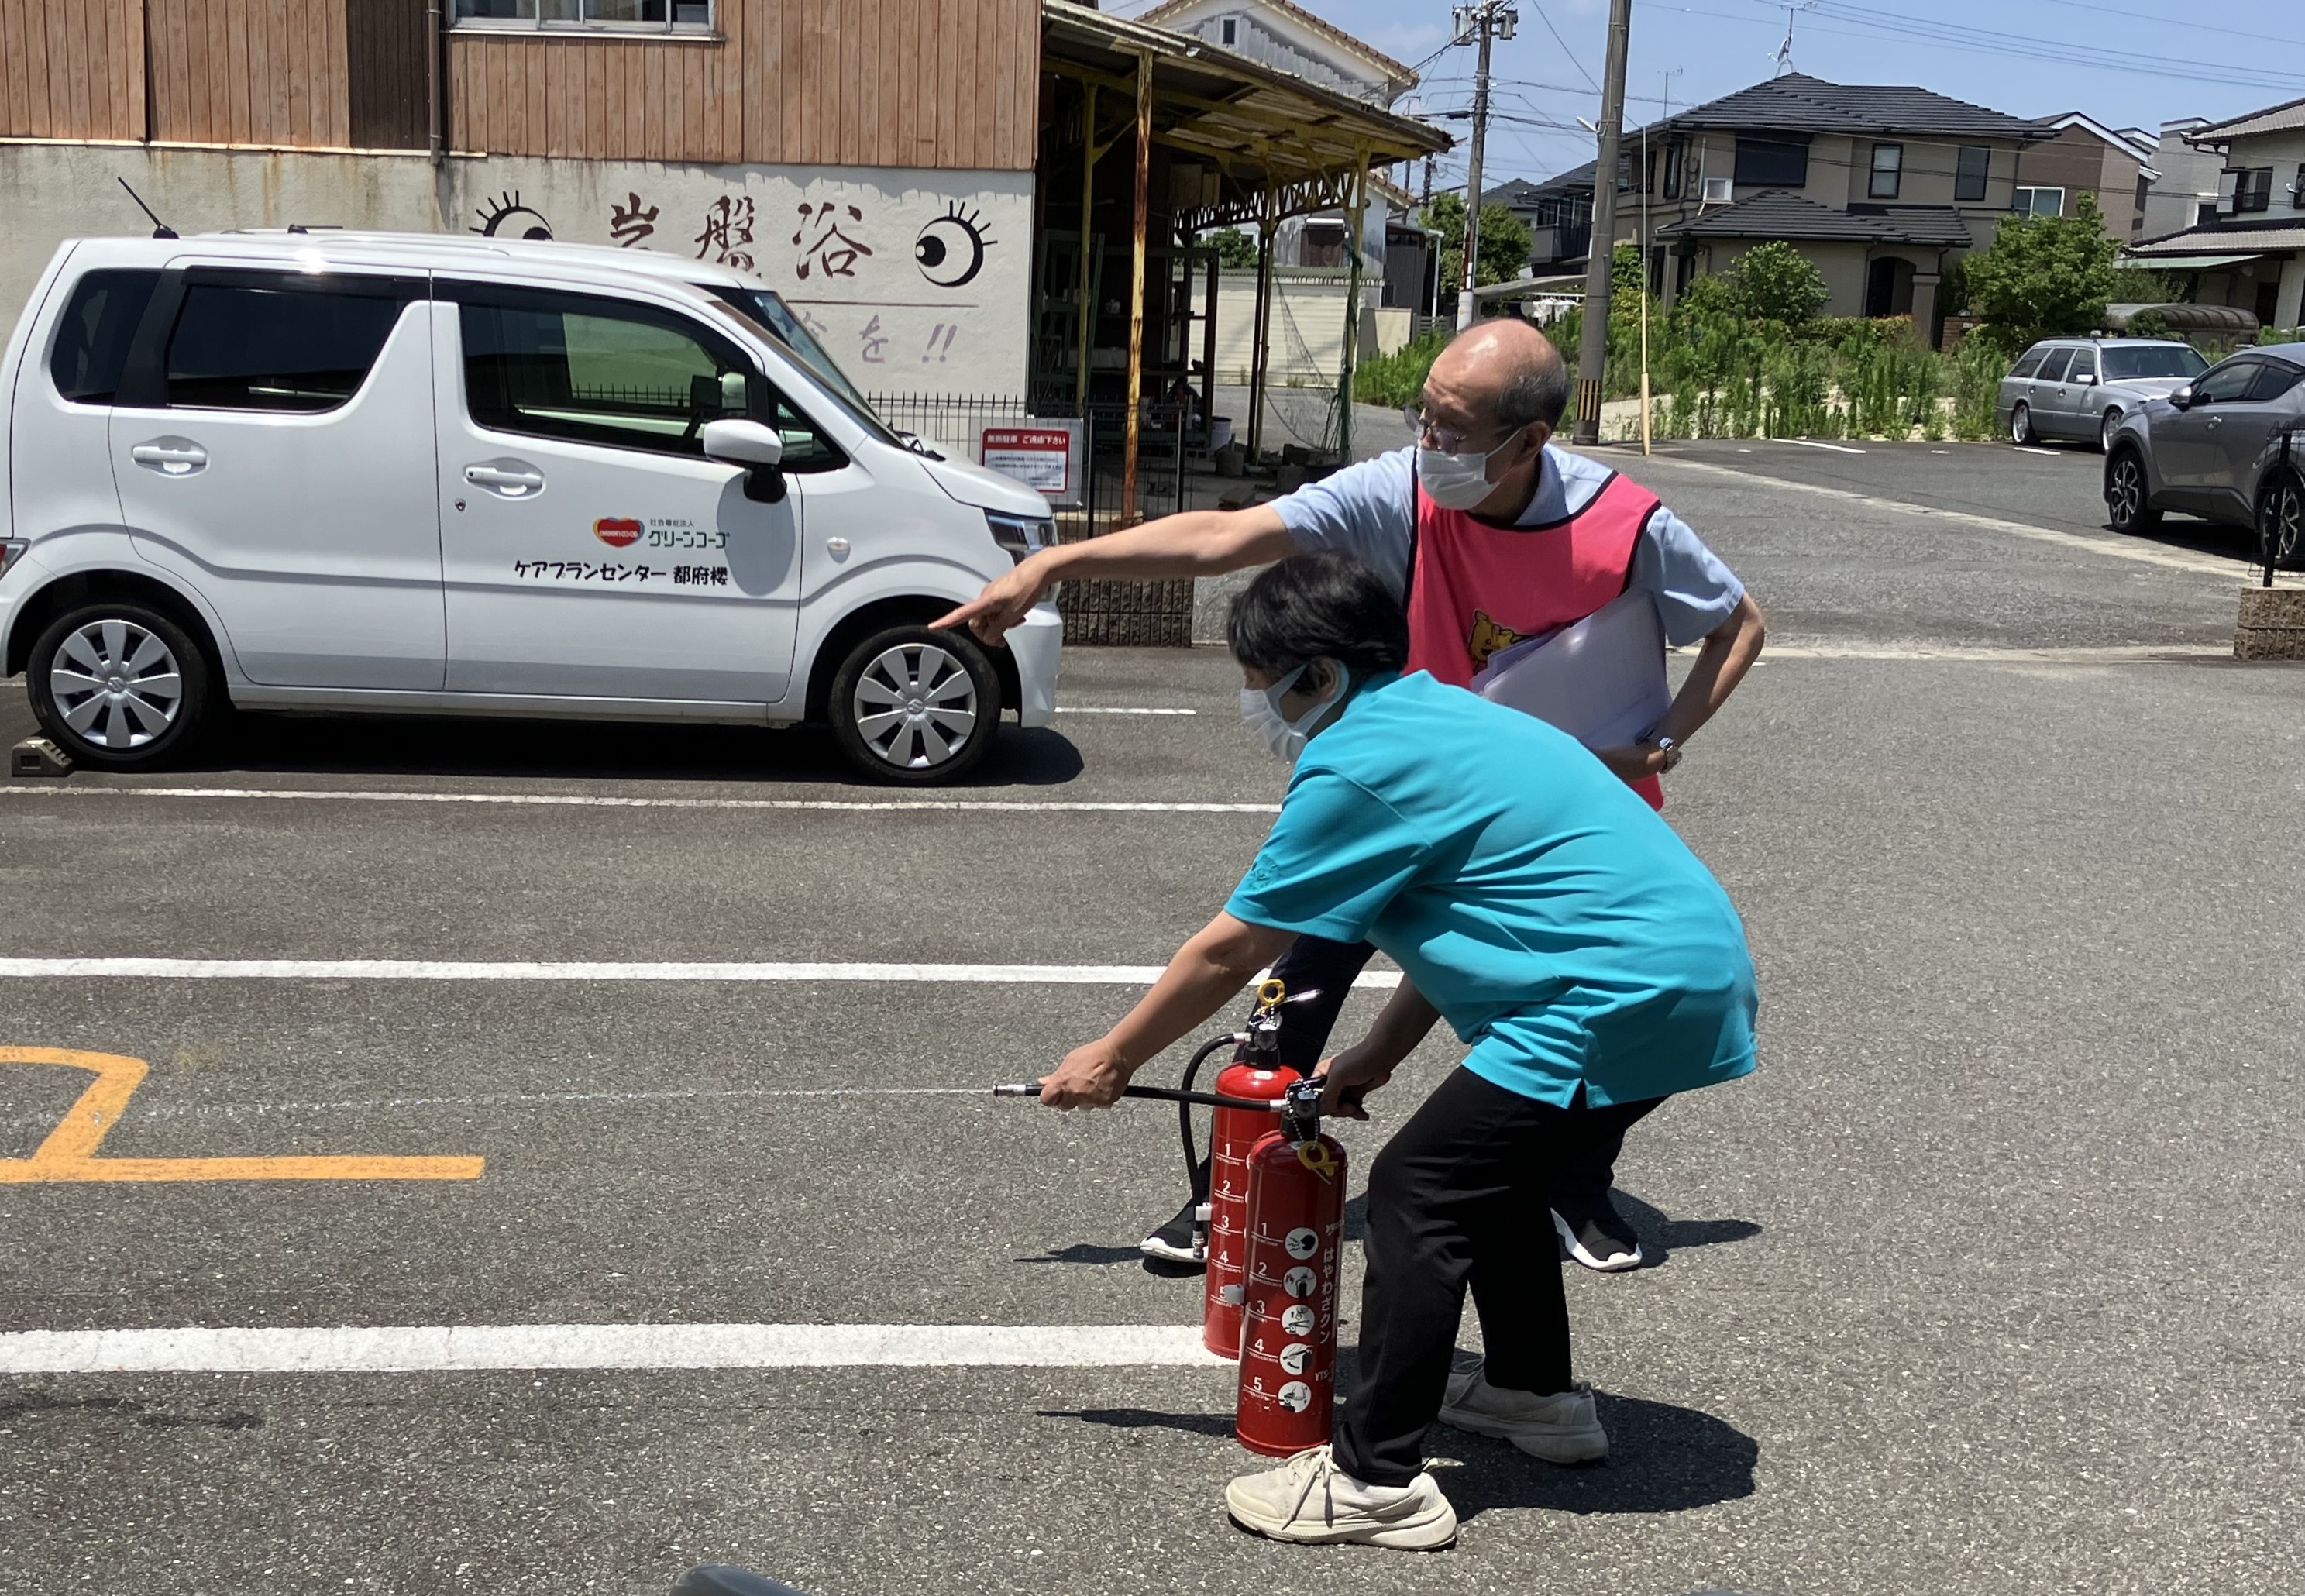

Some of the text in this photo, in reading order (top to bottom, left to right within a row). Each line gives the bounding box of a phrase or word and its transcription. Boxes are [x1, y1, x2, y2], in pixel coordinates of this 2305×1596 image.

[648, 531, 731, 549] グリーンコープ
[1225, 1143, 1230, 1157] 1
[1222, 1180, 1230, 1194] 2
[1221, 1215, 1230, 1229] 3
[1261, 1222, 1268, 1236] 1
[1220, 1250, 1229, 1264] 4
[1258, 1261, 1268, 1277] 2
[1319, 1248, 1335, 1344] はやわざクン
[1257, 1300, 1265, 1315] 3
[1254, 1338, 1264, 1352] 4
[1254, 1377, 1262, 1391] 5
